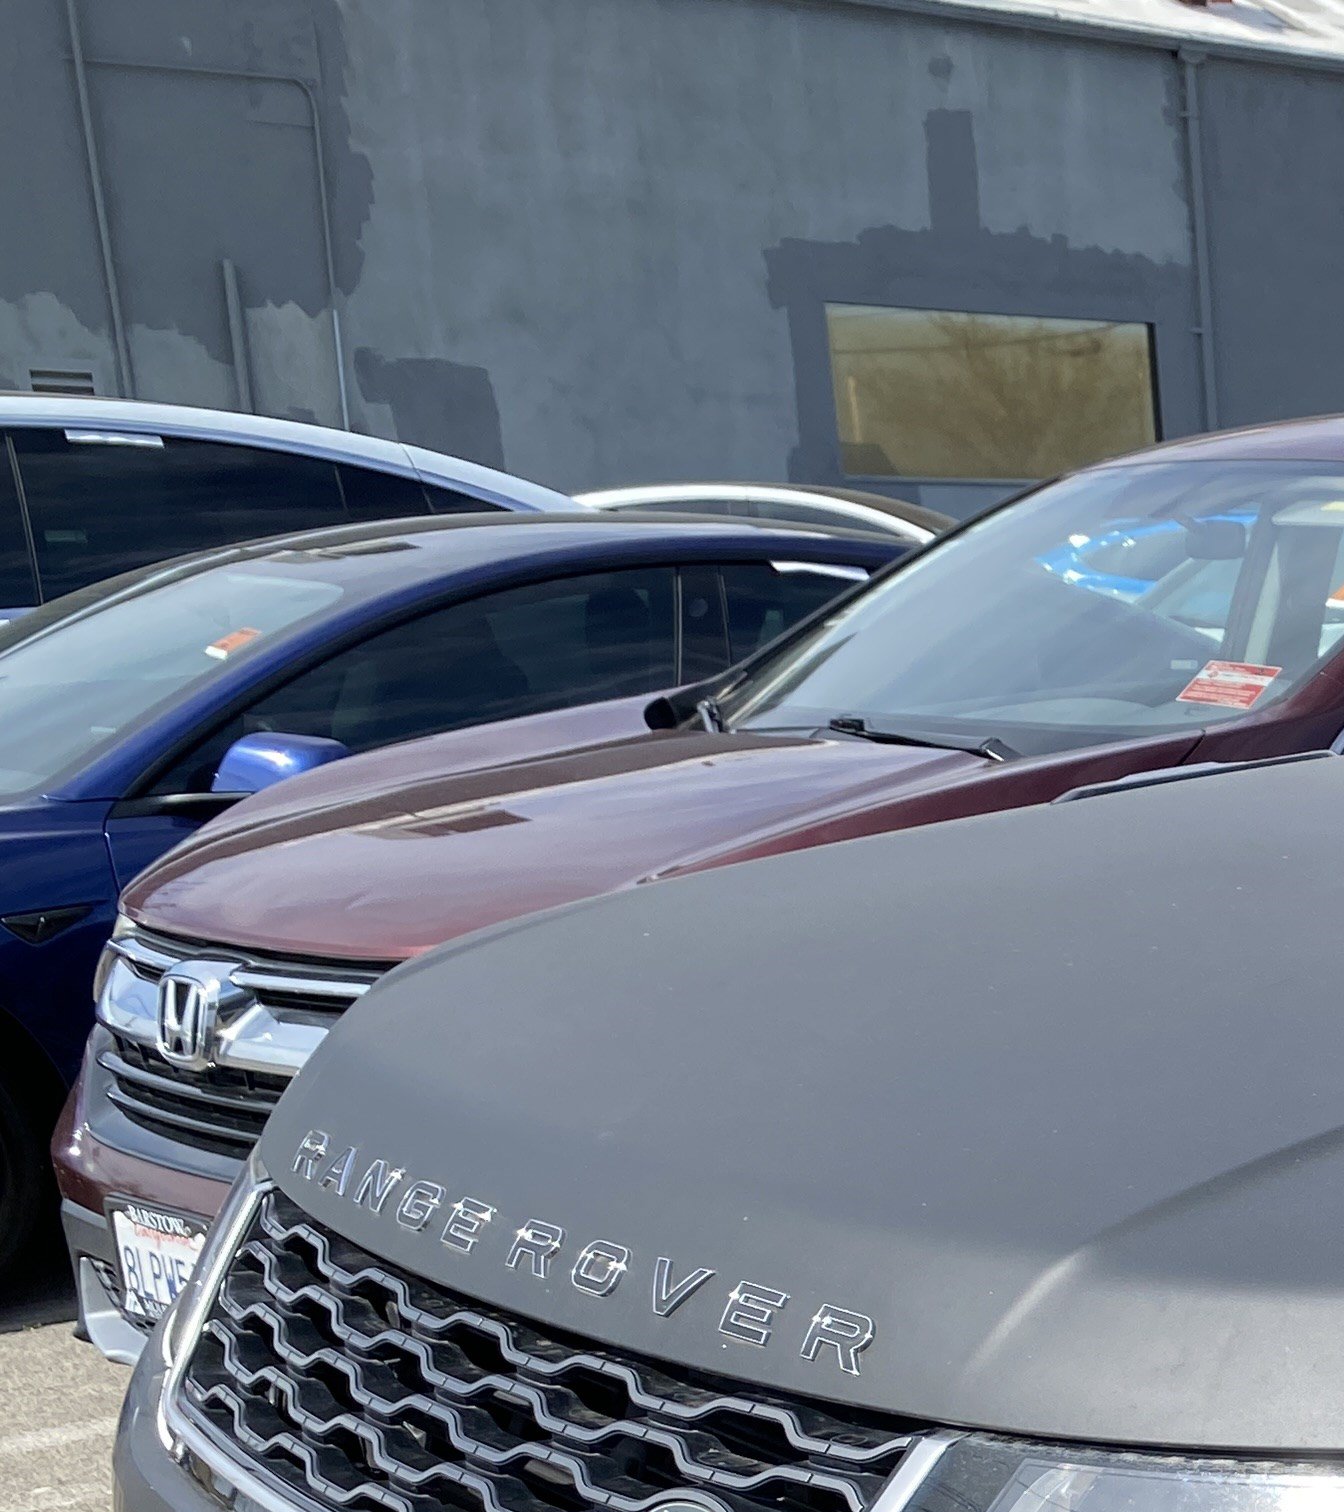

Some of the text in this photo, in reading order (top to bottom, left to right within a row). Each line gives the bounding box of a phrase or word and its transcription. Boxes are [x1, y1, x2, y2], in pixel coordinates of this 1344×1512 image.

[123, 1245, 193, 1302] 8LPW5
[292, 1129, 876, 1376] RANGE ROVER
